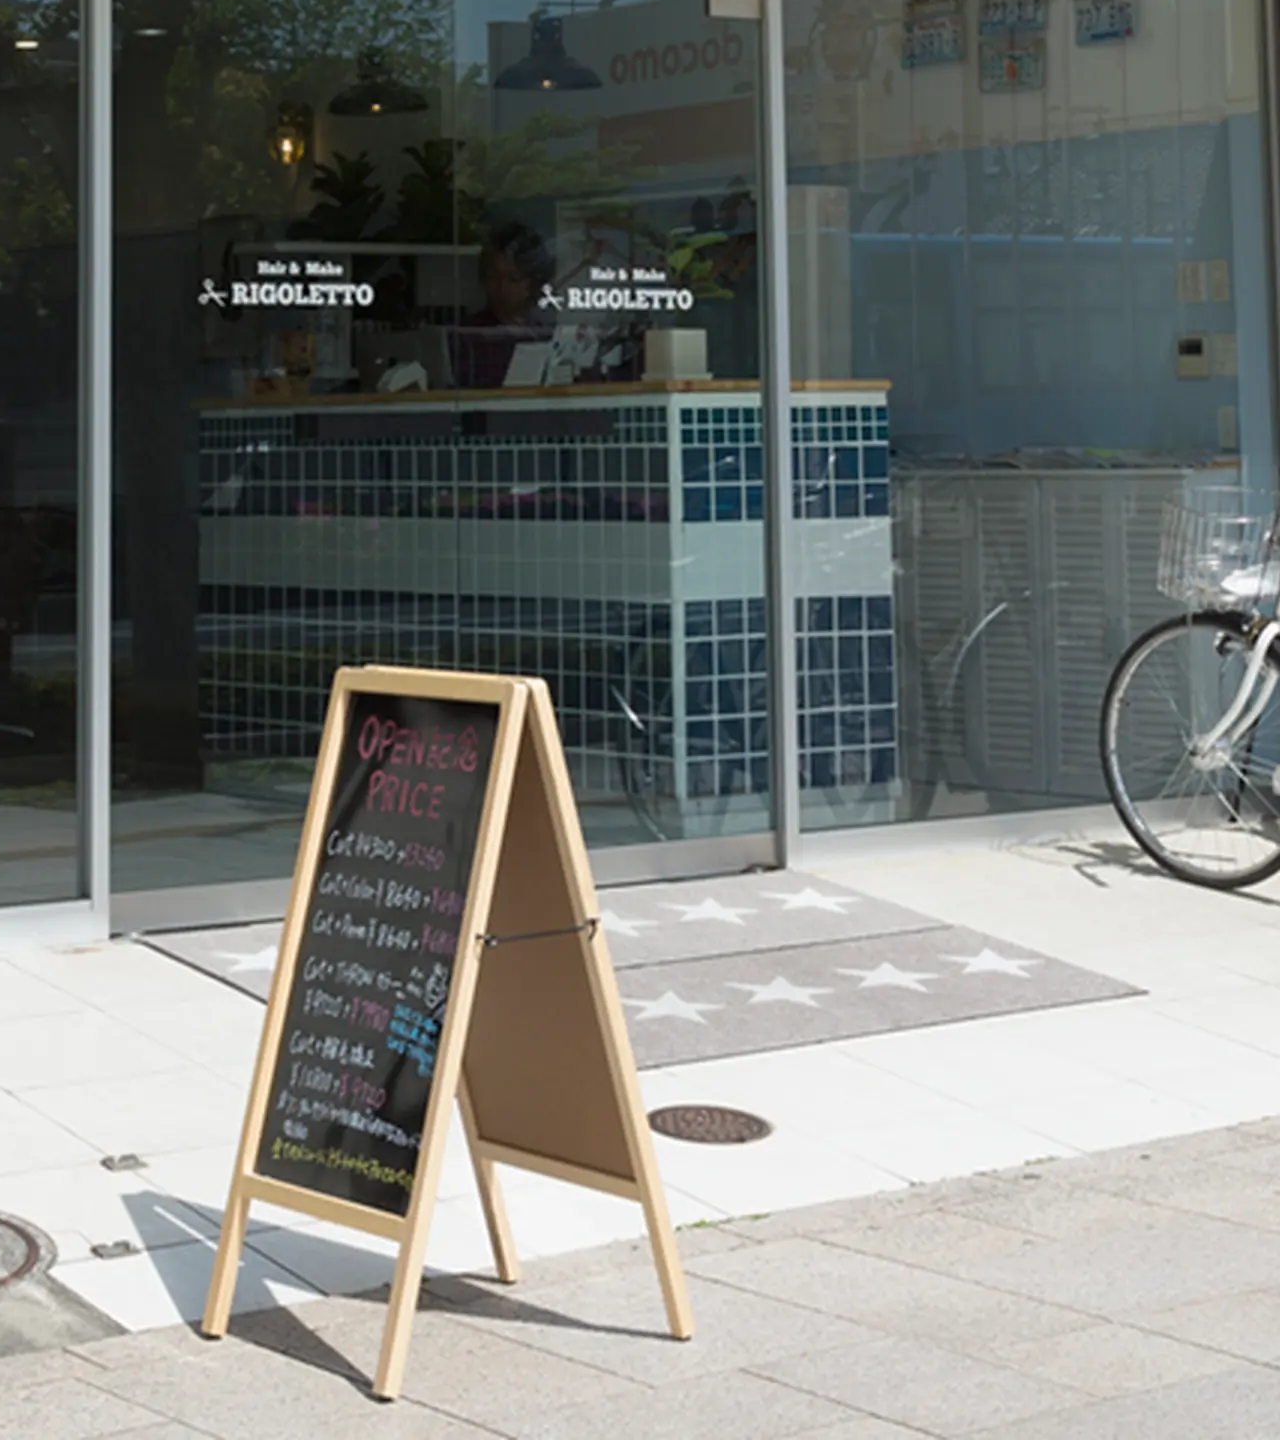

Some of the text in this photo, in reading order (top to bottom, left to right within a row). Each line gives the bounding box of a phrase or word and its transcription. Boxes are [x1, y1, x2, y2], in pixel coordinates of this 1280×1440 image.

[256, 260, 344, 276] Hair & Make
[590, 266, 667, 282] Hair & Make
[231, 282, 375, 306] RIGOLETTO
[567, 287, 694, 310] RIGOLETTO
[366, 768, 446, 819] PRICE
